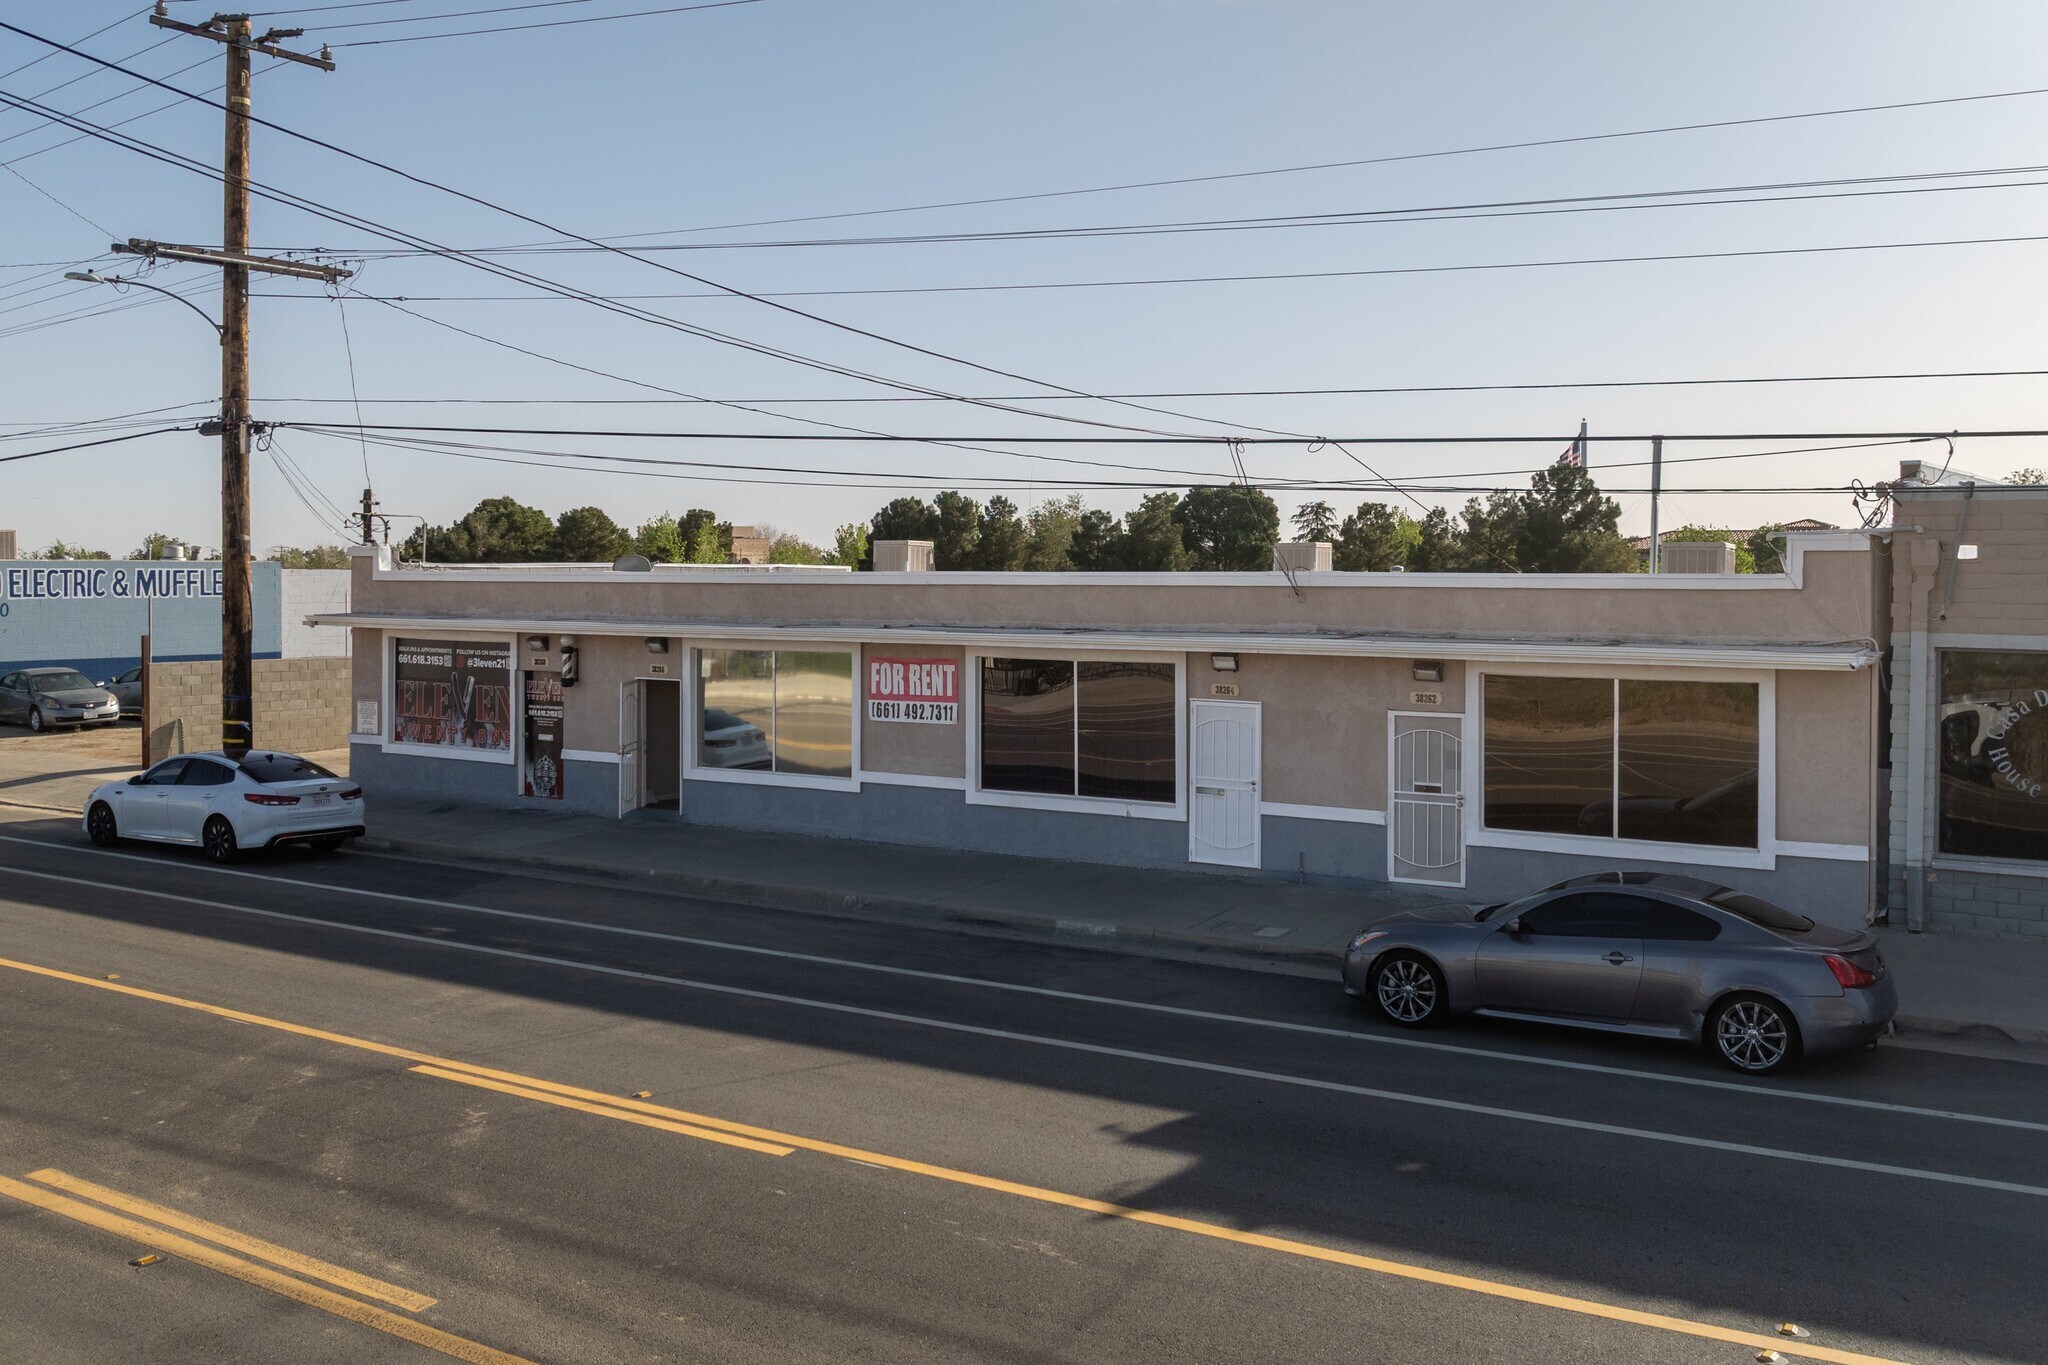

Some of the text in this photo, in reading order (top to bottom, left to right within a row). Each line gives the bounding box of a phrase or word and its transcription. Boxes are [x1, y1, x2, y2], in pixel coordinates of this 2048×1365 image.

[7, 568, 107, 599] ELECTRIC
[112, 568, 130, 598] &
[134, 568, 223, 598] MUFFLE
[398, 654, 444, 665] 661.618.3153
[467, 658, 506, 668] @3leven21
[871, 662, 955, 697] FOR RENT
[1214, 685, 1235, 696] 38264
[397, 672, 510, 723] ELEVEN
[1415, 693, 1437, 704] 38262
[871, 702, 953, 721] (661) 492.7311
[1986, 700, 2031, 740] Casa
[400, 721, 510, 746] TWENTY ONE
[1988, 747, 2041, 798] House
